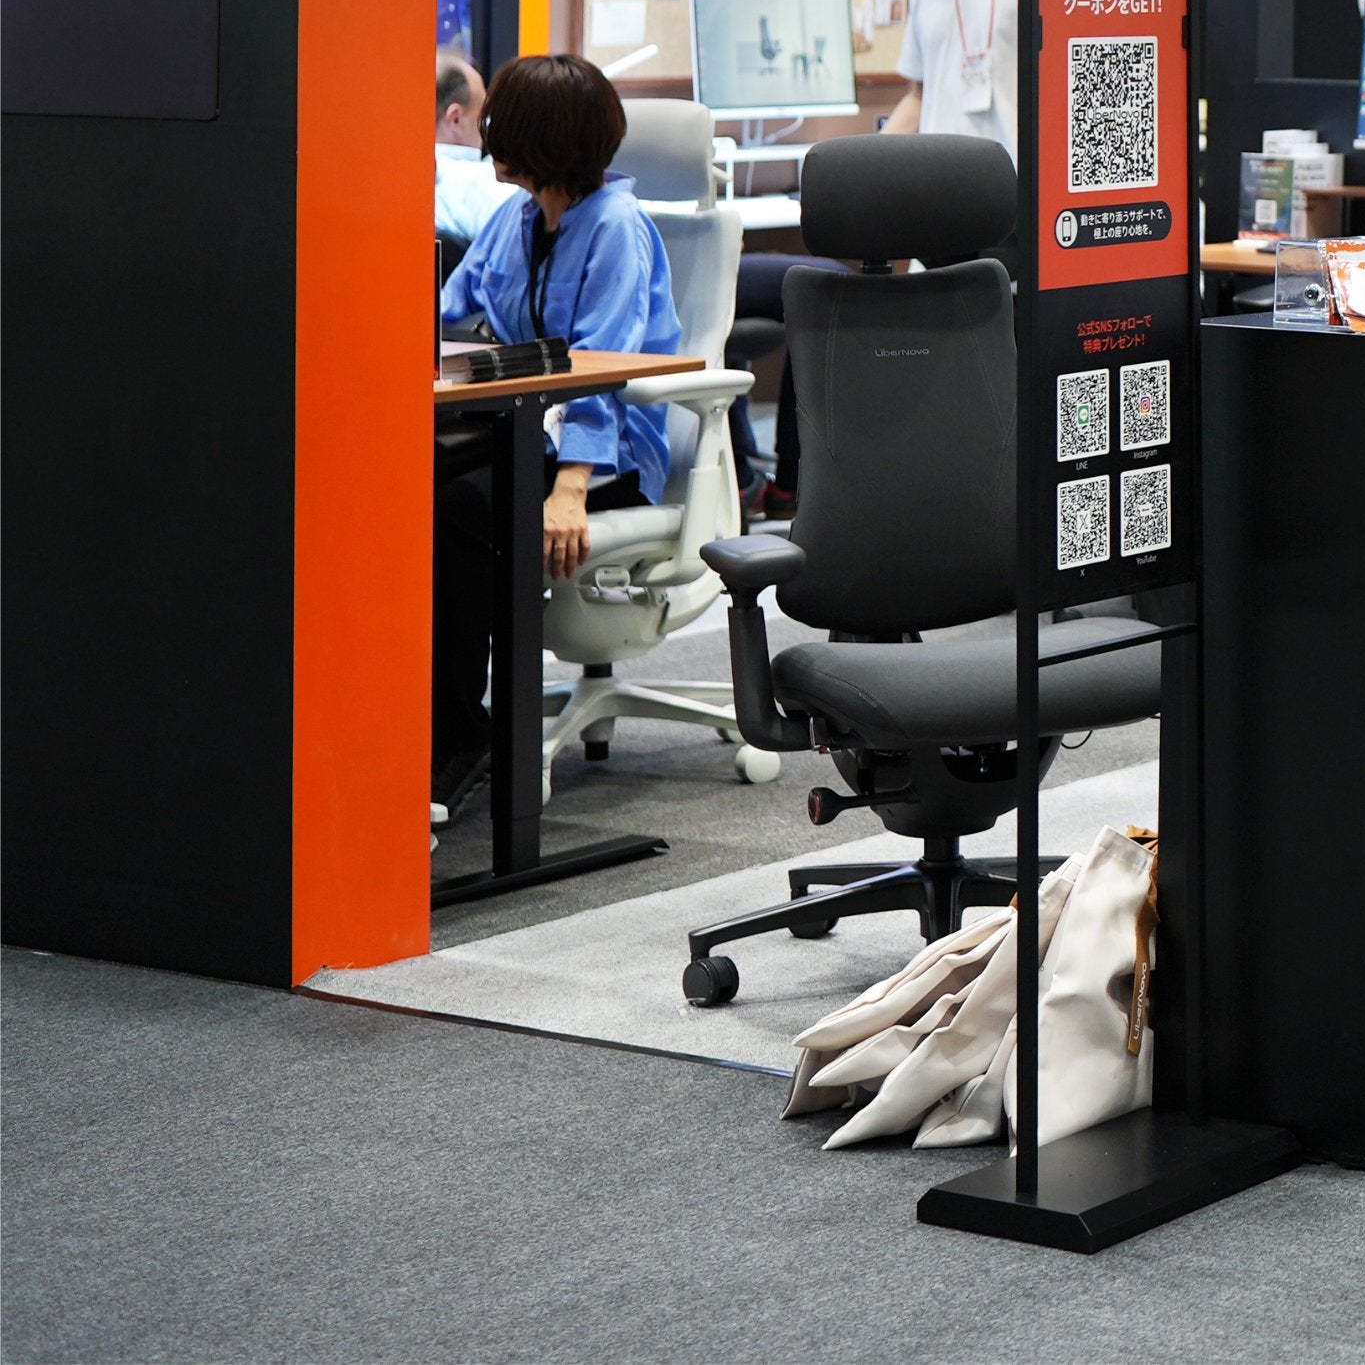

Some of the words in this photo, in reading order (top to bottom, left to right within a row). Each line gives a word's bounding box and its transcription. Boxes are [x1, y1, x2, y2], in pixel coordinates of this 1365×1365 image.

[1076, 314, 1152, 337] 公式SNSフォローで
[874, 347, 930, 357] LiberNovo
[1083, 333, 1146, 355] 特典プレゼント!
[1133, 961, 1147, 1040] LiberNovo
